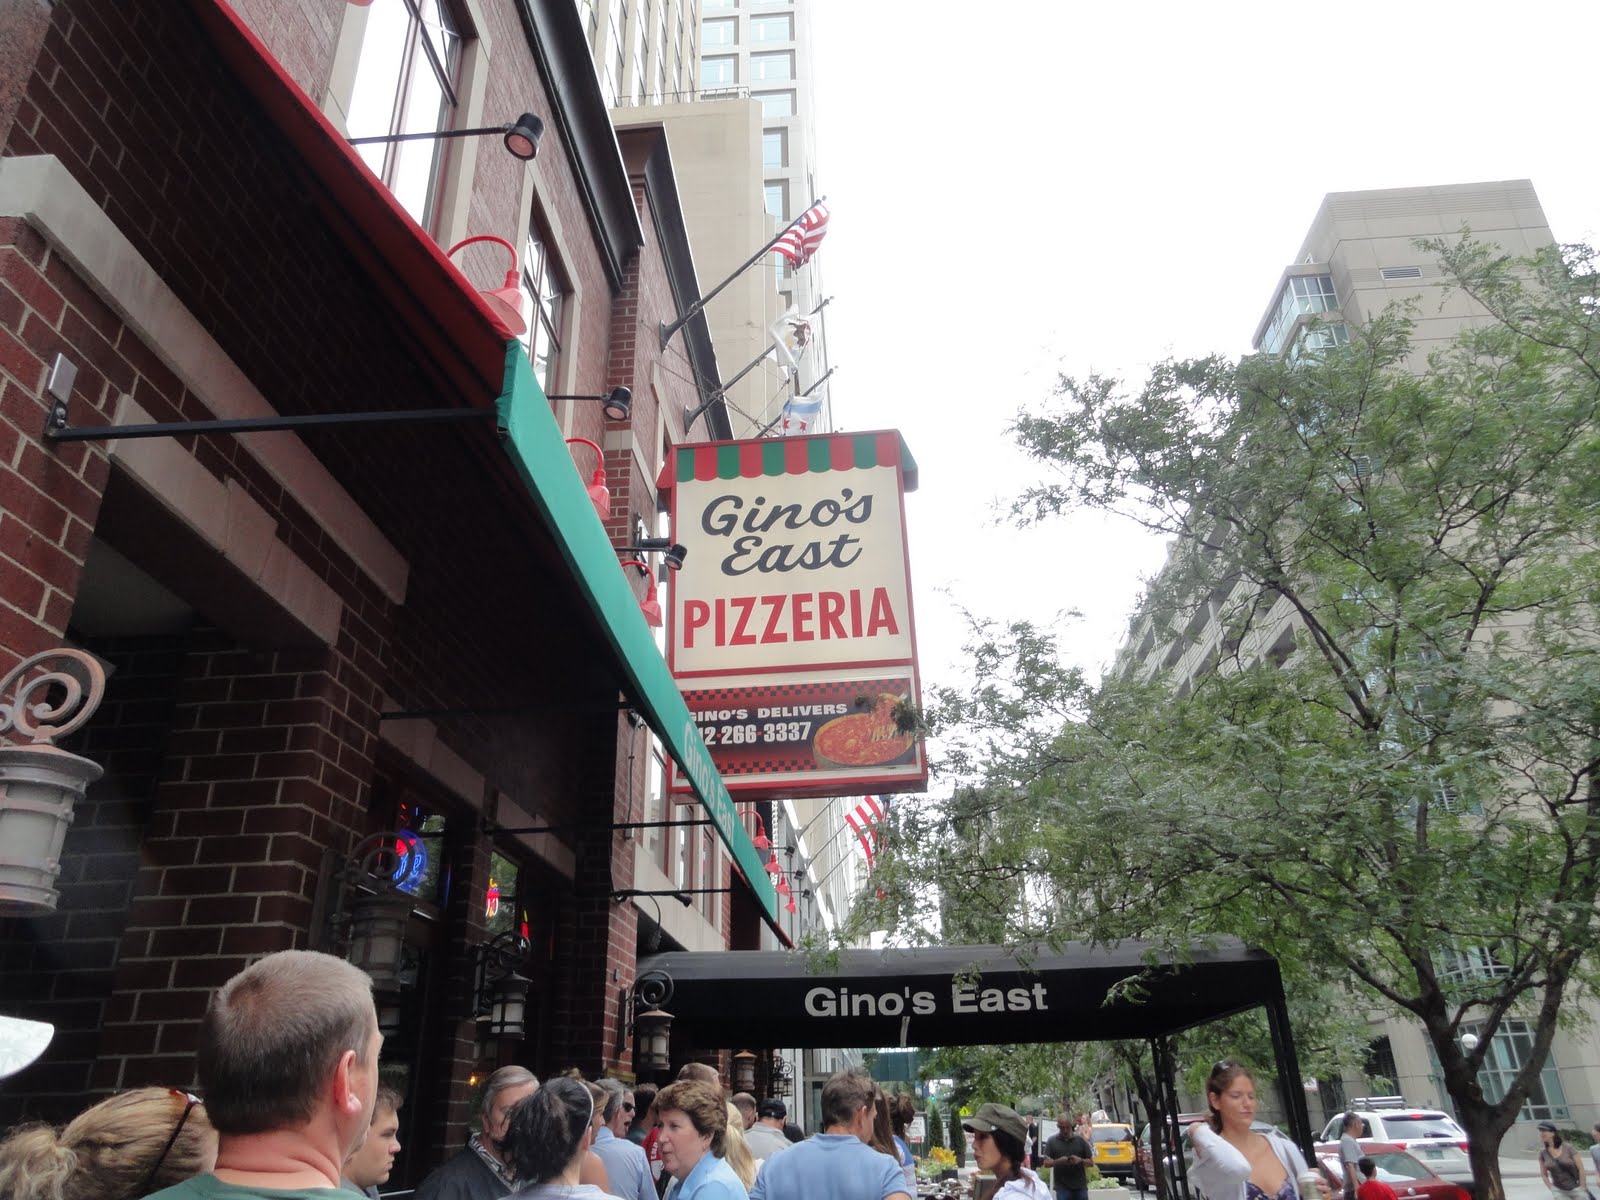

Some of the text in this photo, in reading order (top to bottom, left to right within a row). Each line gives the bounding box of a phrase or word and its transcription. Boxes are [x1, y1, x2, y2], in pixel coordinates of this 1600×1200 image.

[701, 488, 873, 537] Gino's
[721, 534, 863, 576] East
[683, 587, 899, 648] PIZZERIA
[757, 703, 848, 719] DELIVERS
[804, 983, 1048, 1017] Gino's East
